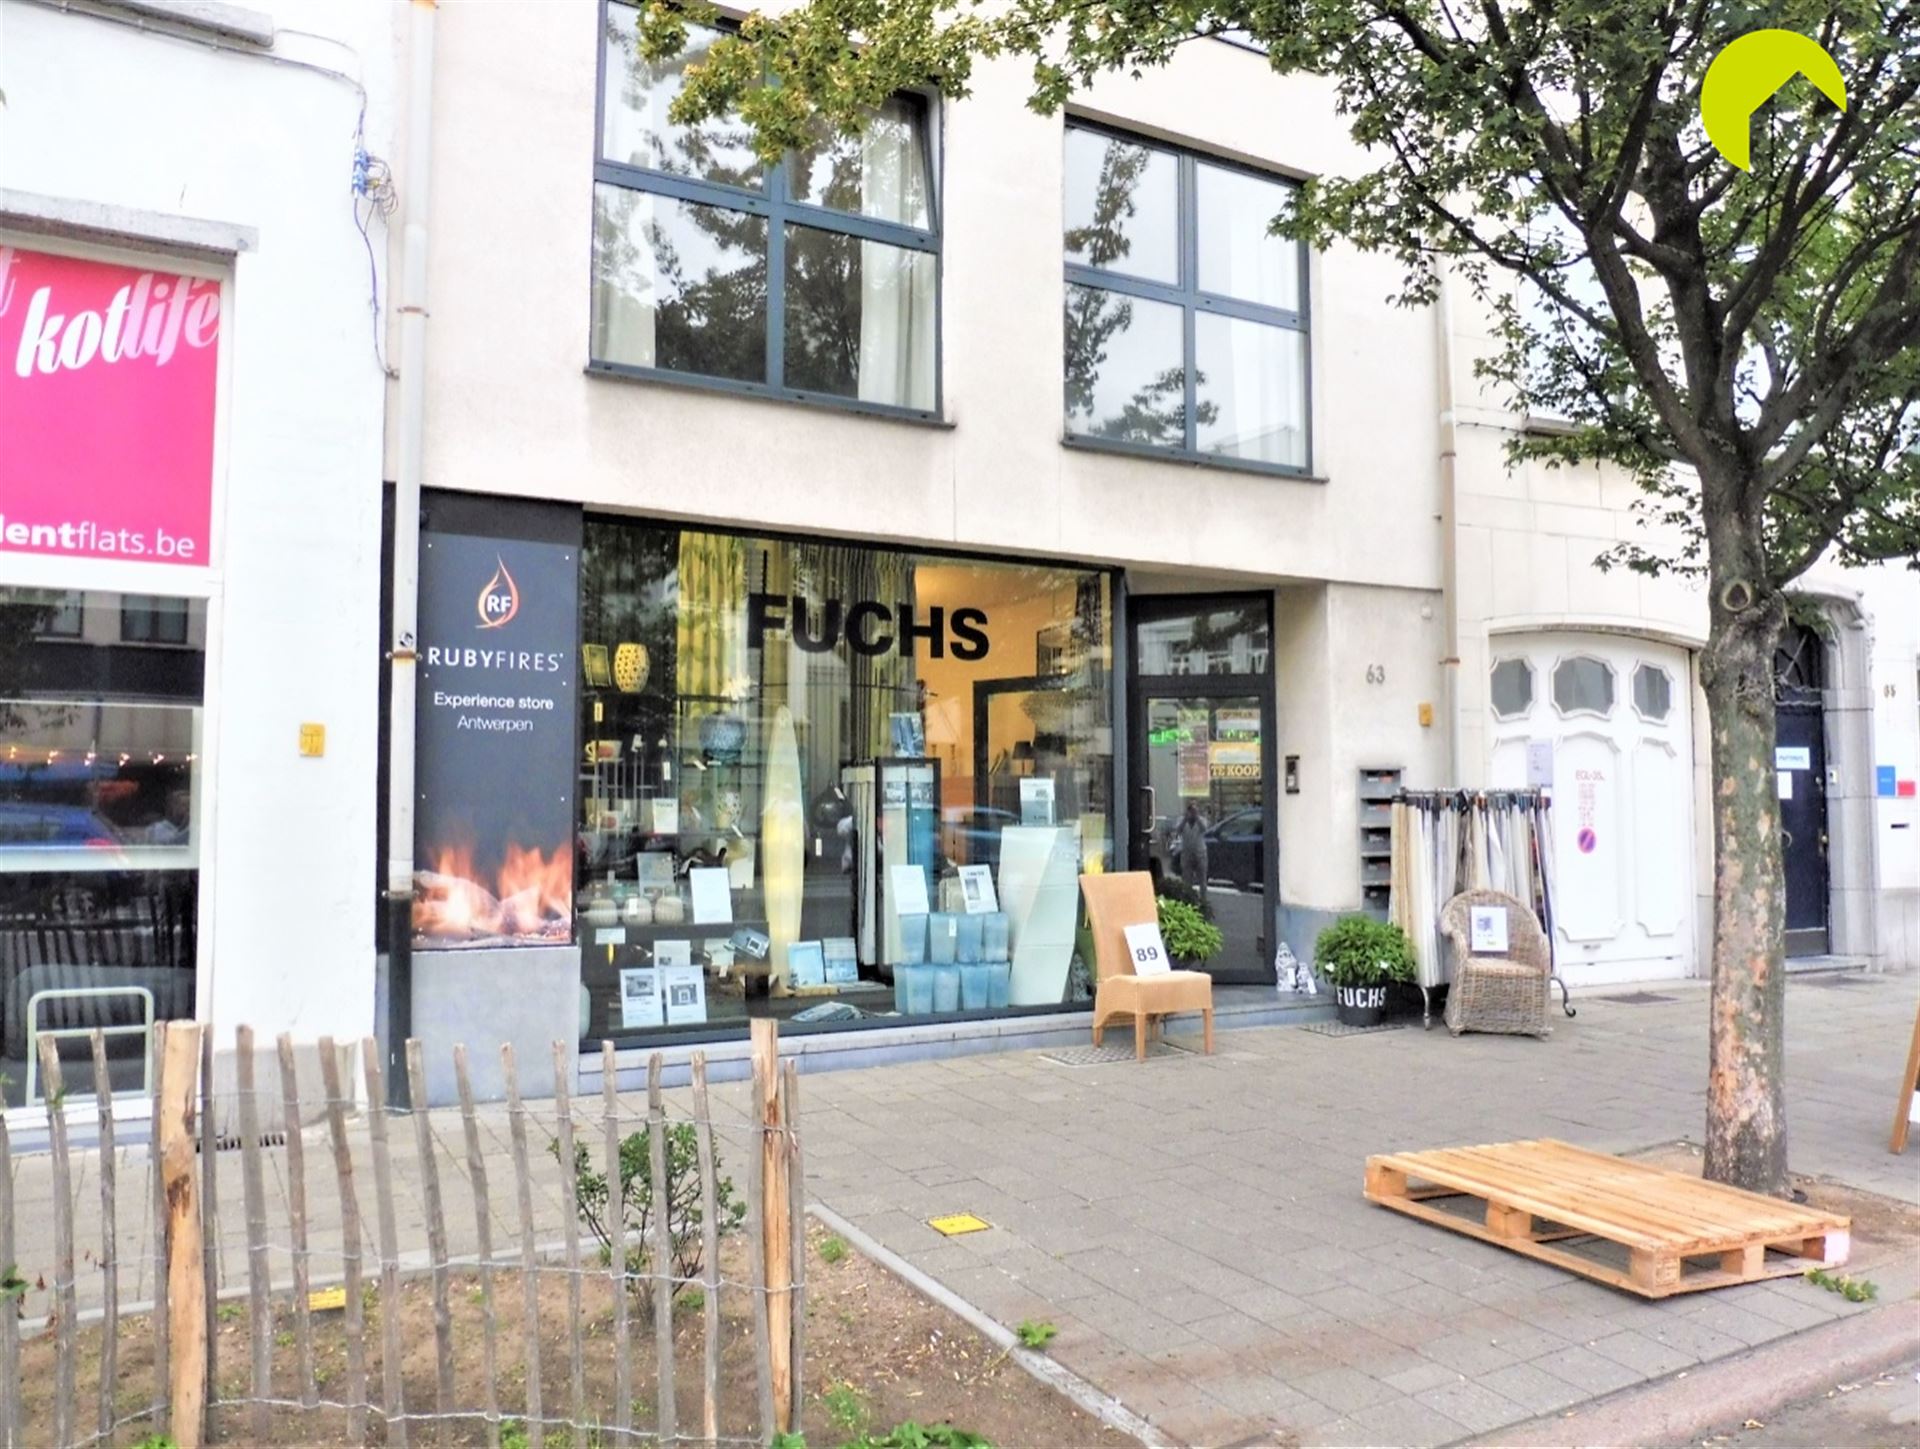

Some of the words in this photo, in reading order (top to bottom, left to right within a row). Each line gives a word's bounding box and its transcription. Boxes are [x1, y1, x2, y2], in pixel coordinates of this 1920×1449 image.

[16, 272, 220, 378] kotlife
[487, 594, 513, 613] RF
[747, 592, 989, 661] FUCHS
[428, 646, 560, 672] RUBYFIRES
[1366, 664, 1385, 684] 63
[433, 691, 515, 709] Experience
[519, 696, 554, 710] store
[457, 715, 534, 732] Antwerpen
[1227, 765, 1259, 777] KOOP
[1136, 946, 1159, 962] 89
[1336, 986, 1387, 1008] FUCHS
